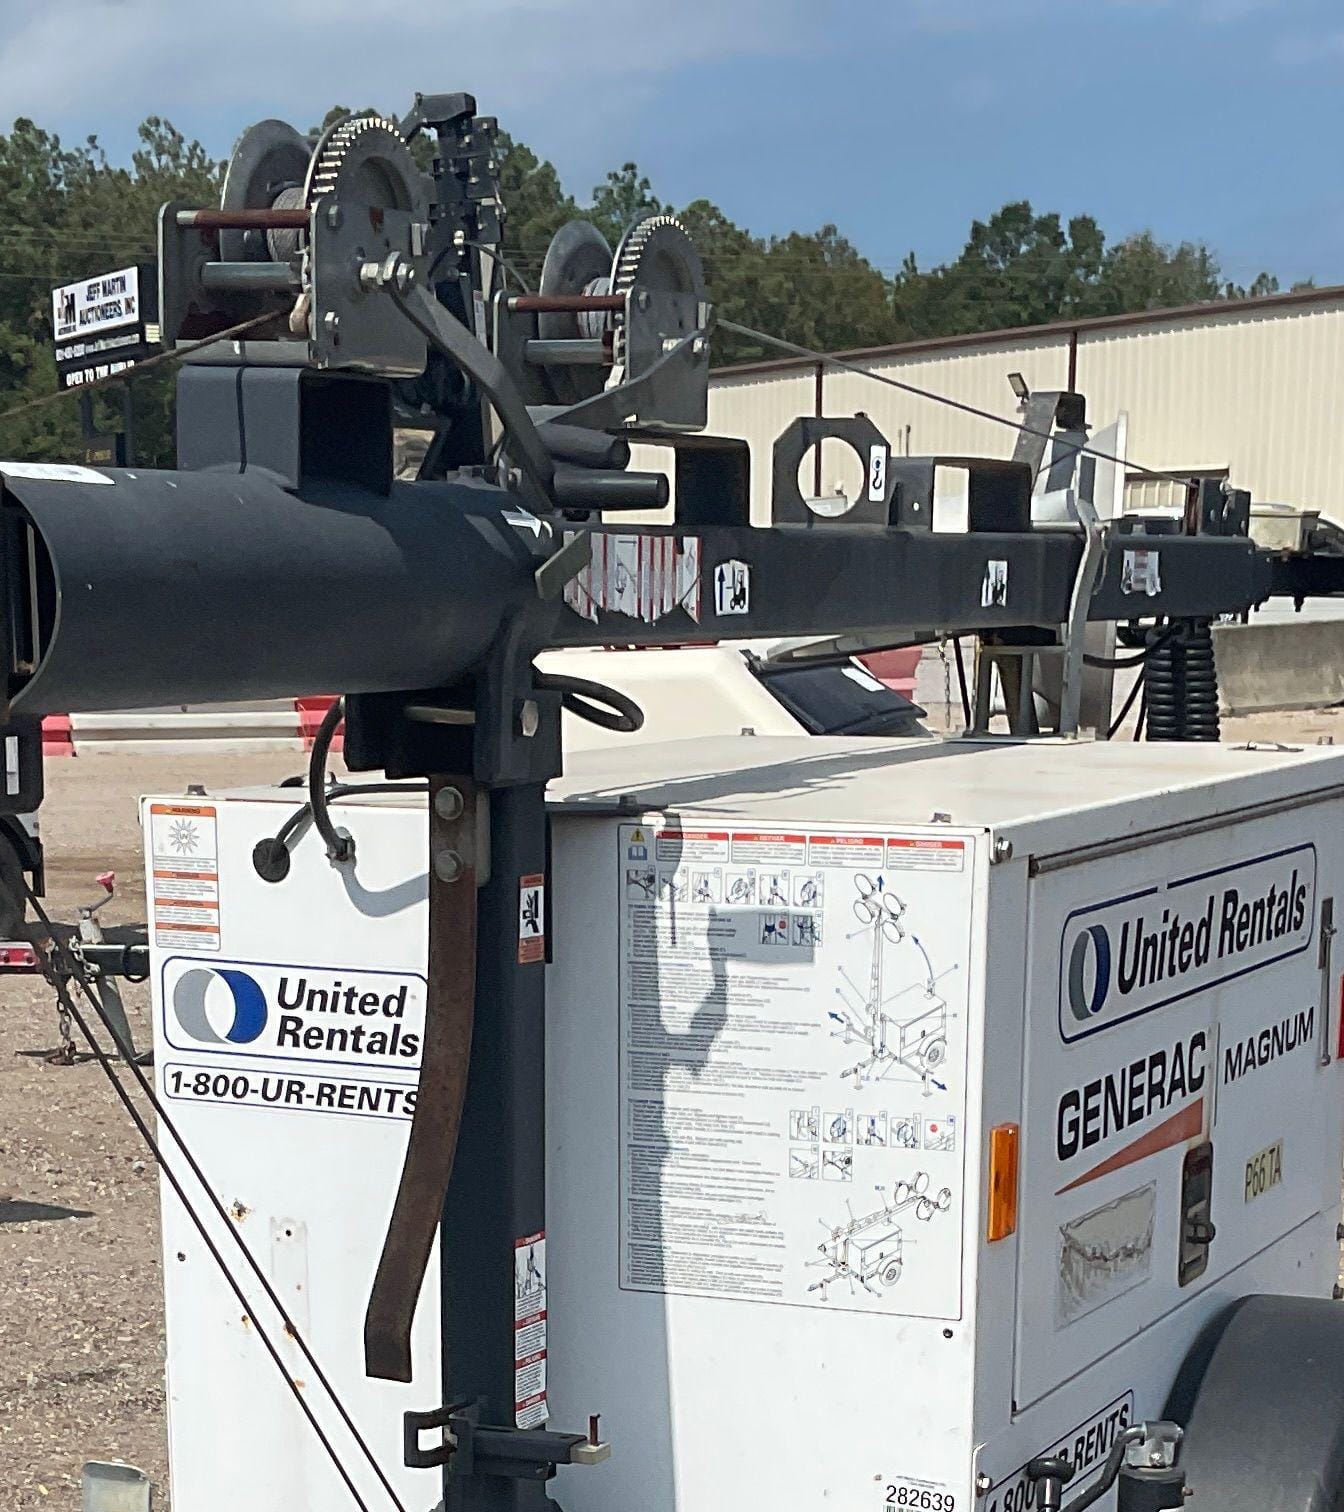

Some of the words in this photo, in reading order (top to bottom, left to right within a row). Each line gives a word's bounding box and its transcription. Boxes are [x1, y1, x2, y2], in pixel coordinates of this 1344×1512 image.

[1117, 896, 1215, 995] United
[1217, 869, 1307, 959] Rentals
[277, 977, 408, 1018] United
[276, 1015, 420, 1058] Rentals
[170, 1070, 418, 1116] 1-800-UR-RENTS
[1057, 1031, 1206, 1161] GENERAC
[1223, 1006, 1314, 1085] MAGNUM
[885, 1484, 955, 1512] 282639
